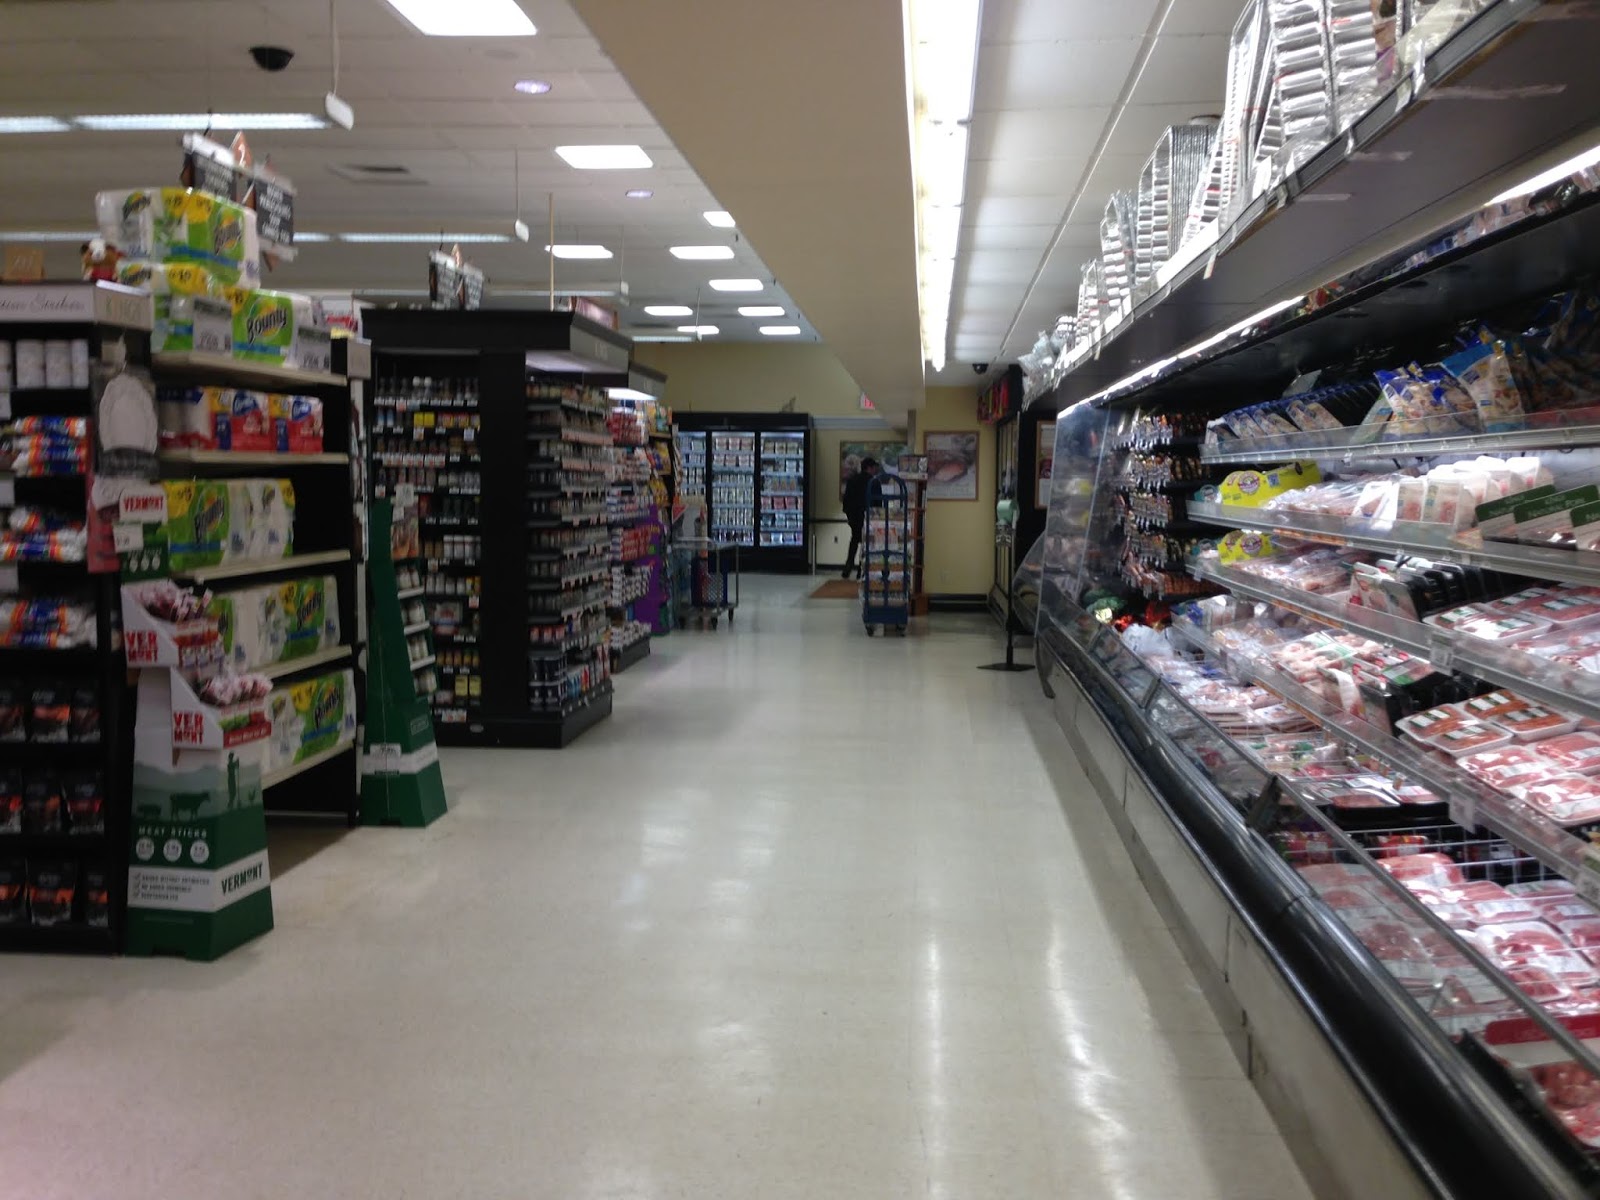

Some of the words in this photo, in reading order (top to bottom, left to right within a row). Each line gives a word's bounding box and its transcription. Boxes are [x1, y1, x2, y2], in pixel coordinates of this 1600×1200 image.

[246, 307, 287, 344] Bounty
[123, 496, 164, 513] VERMONT
[126, 630, 158, 647] VER
[173, 711, 204, 729] VER
[221, 863, 264, 896] VERMONT
